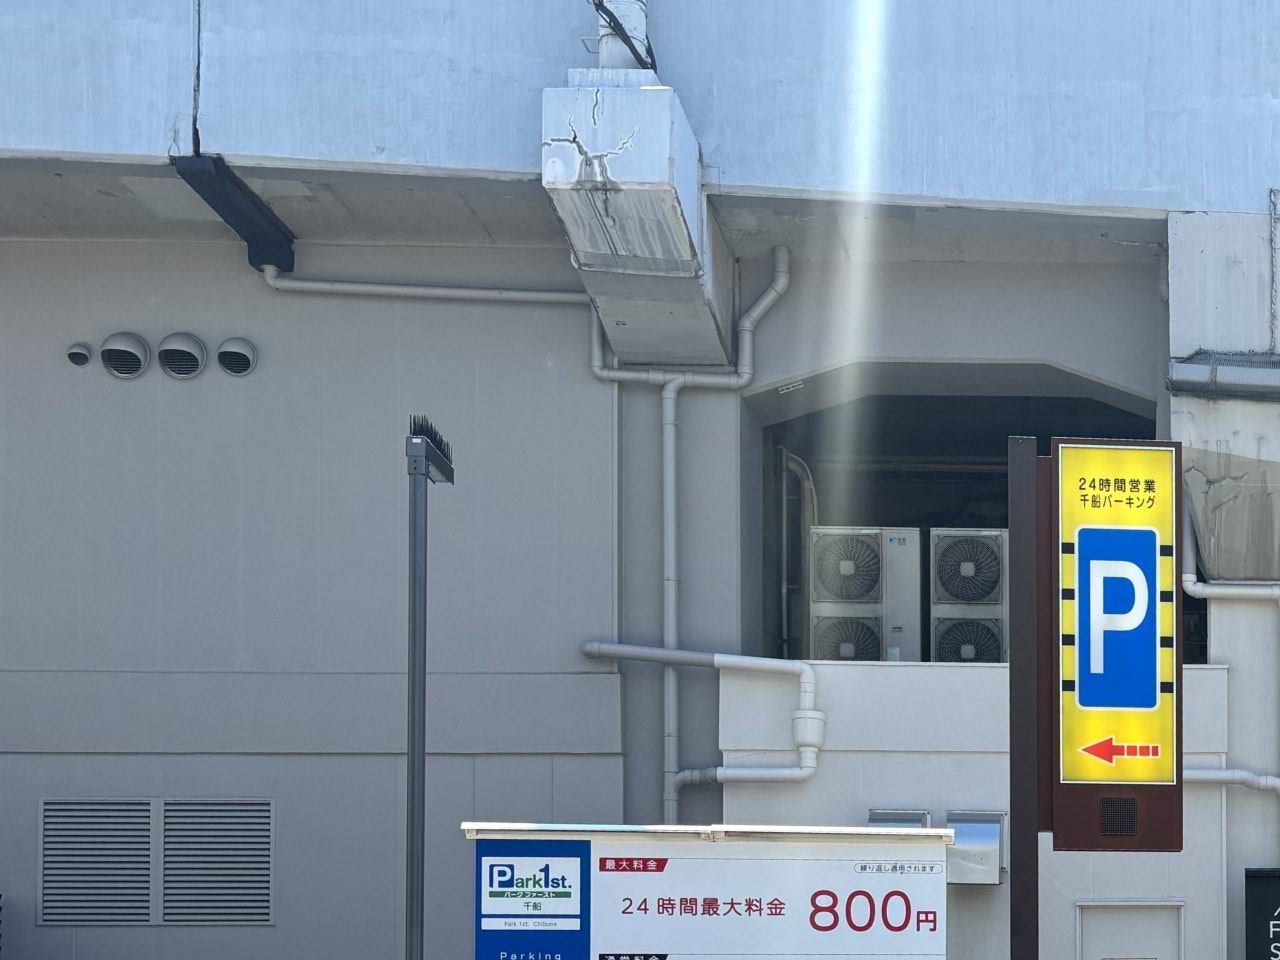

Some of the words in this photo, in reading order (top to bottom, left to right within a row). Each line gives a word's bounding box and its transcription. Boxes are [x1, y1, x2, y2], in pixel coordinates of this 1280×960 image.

[1078, 477, 1156, 494] 24時間営業
[1080, 494, 1156, 509] 千船パーキング
[1089, 559, 1149, 674] P
[604, 859, 658, 870] 最大料金
[523, 902, 542, 911] 千船
[809, 889, 937, 932] 800円
